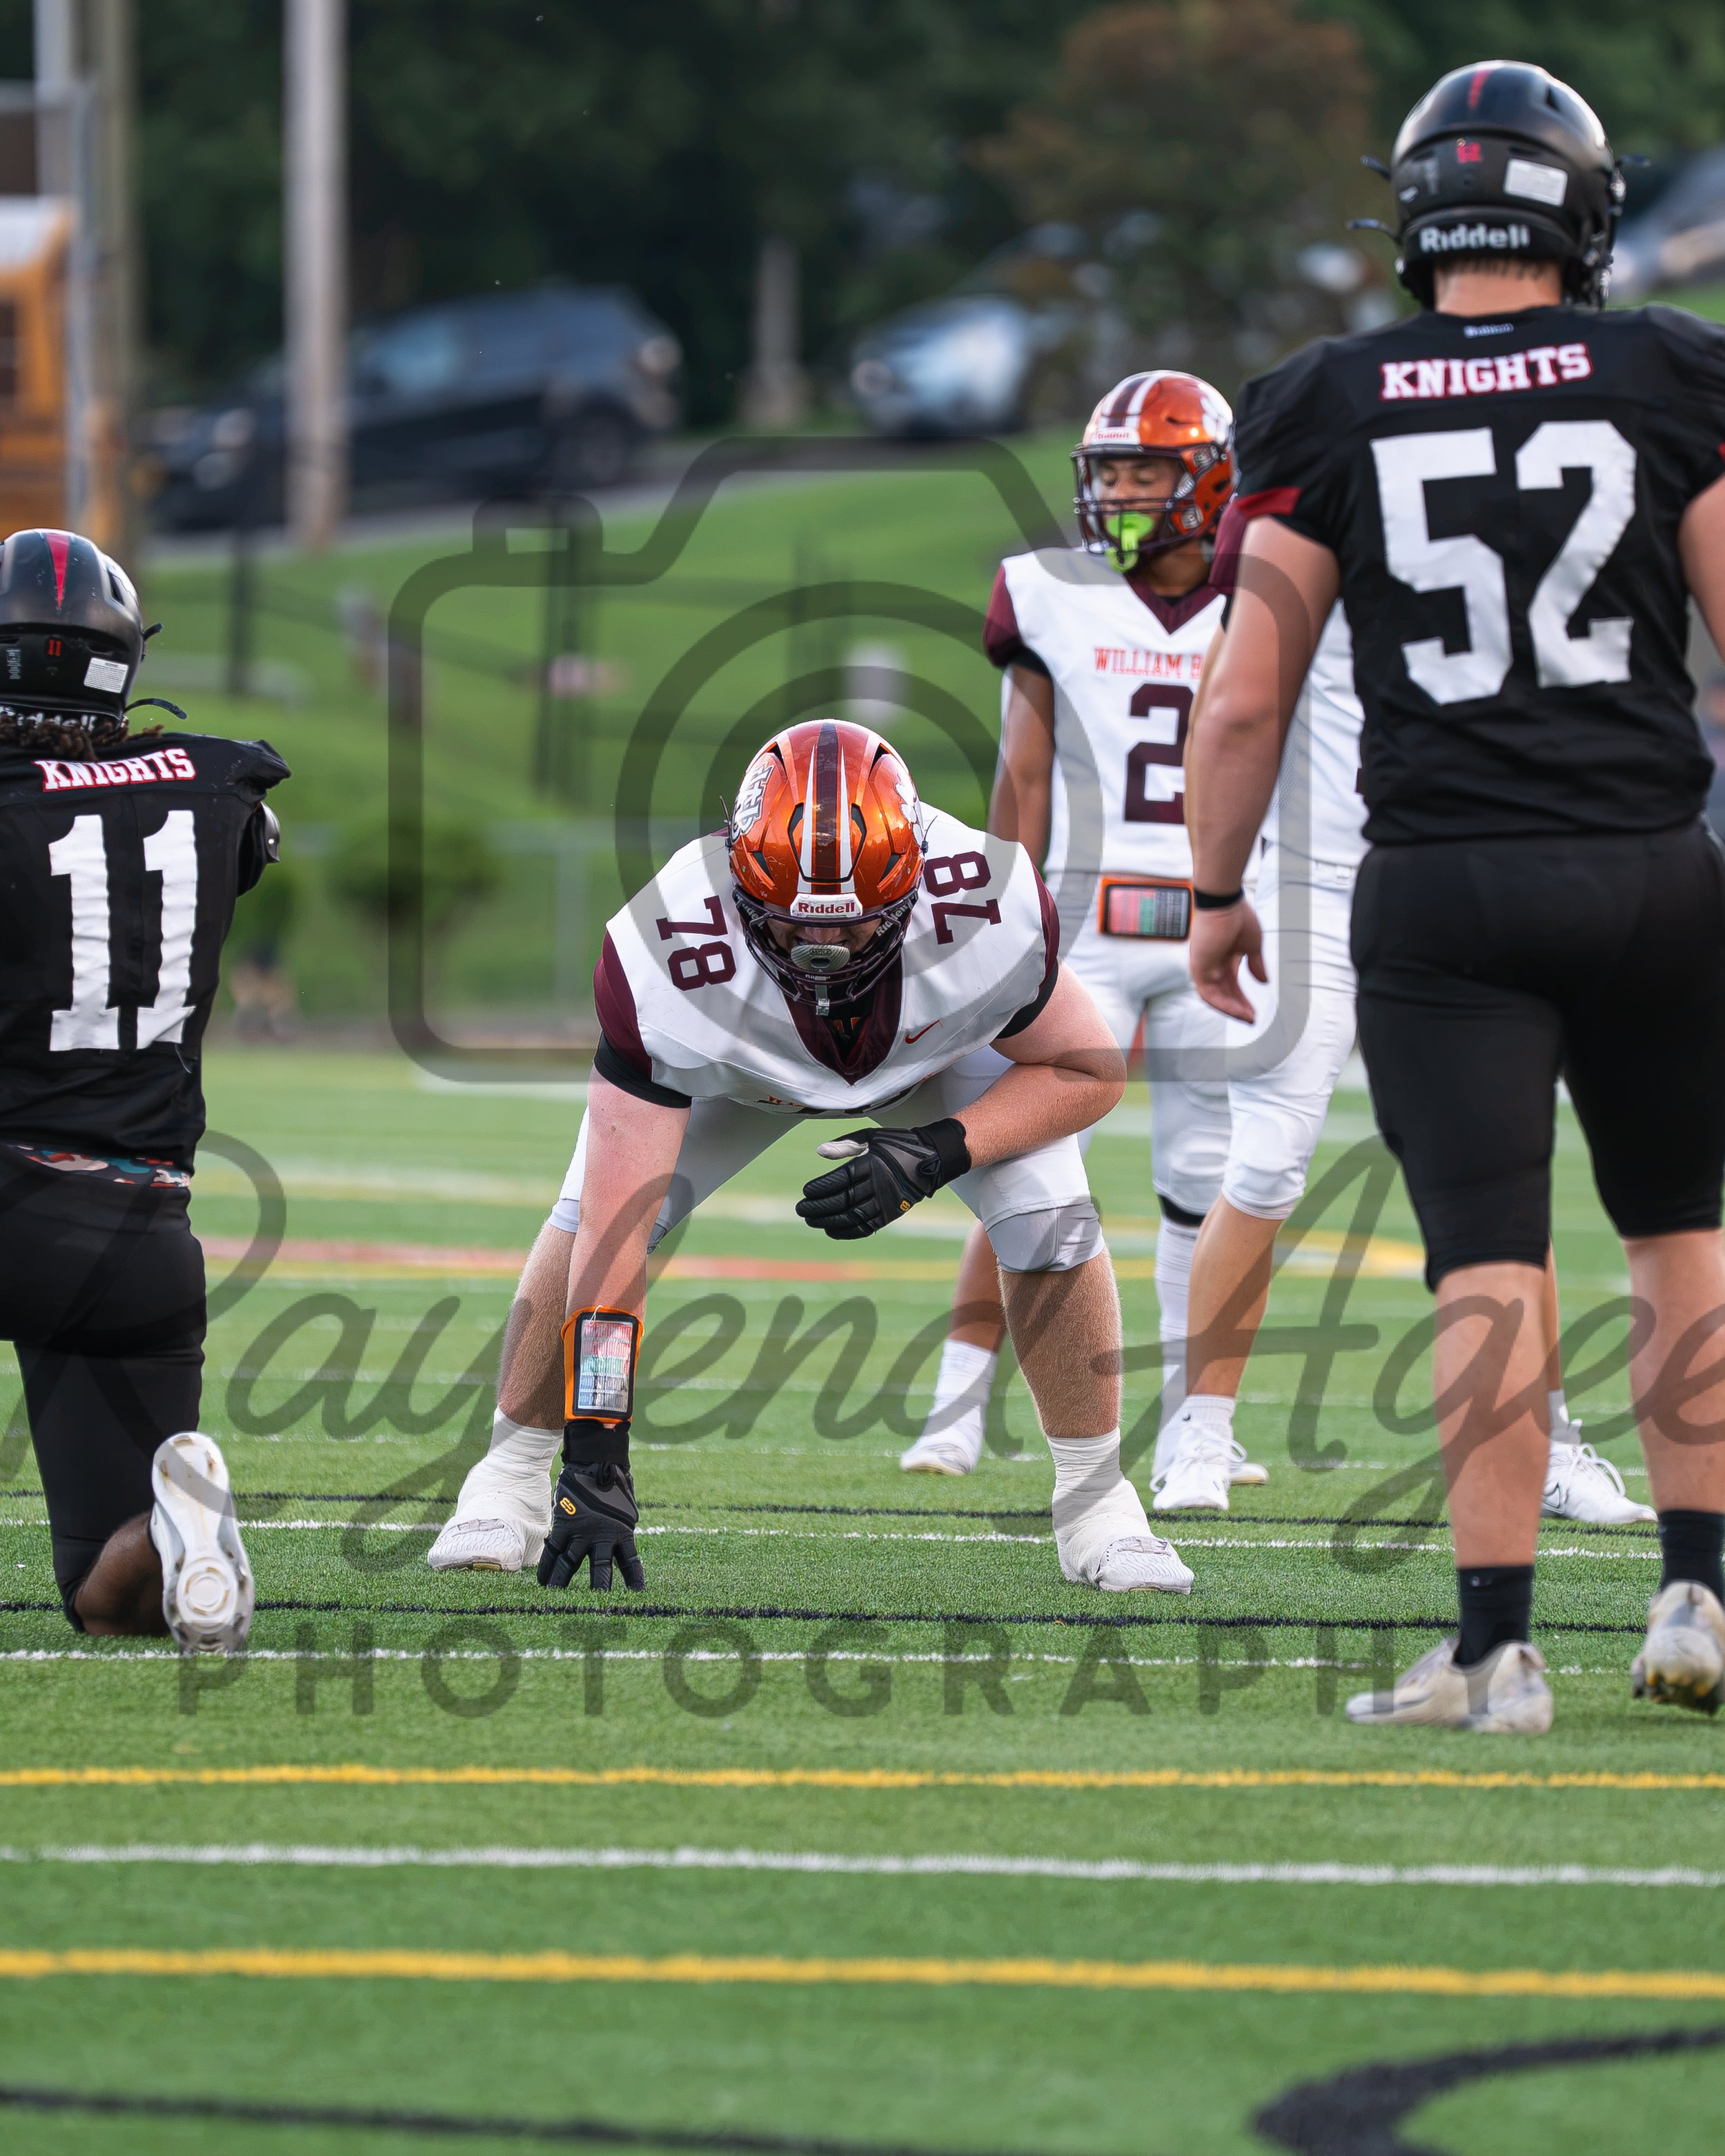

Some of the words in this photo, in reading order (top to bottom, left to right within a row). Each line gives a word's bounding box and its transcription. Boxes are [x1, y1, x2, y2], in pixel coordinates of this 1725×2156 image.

[1419, 222, 1530, 253] Riddell
[1381, 342, 1593, 402] KNIGHTS
[1370, 419, 1637, 706] 52
[1093, 646, 1183, 678] WILLIAM
[32, 747, 198, 793] KNIGHTS
[1124, 682, 1194, 825] 2
[48, 809, 198, 1052] 11
[798, 902, 855, 914] Riddell
[923, 851, 1002, 945] 78
[656, 895, 737, 991] 78
